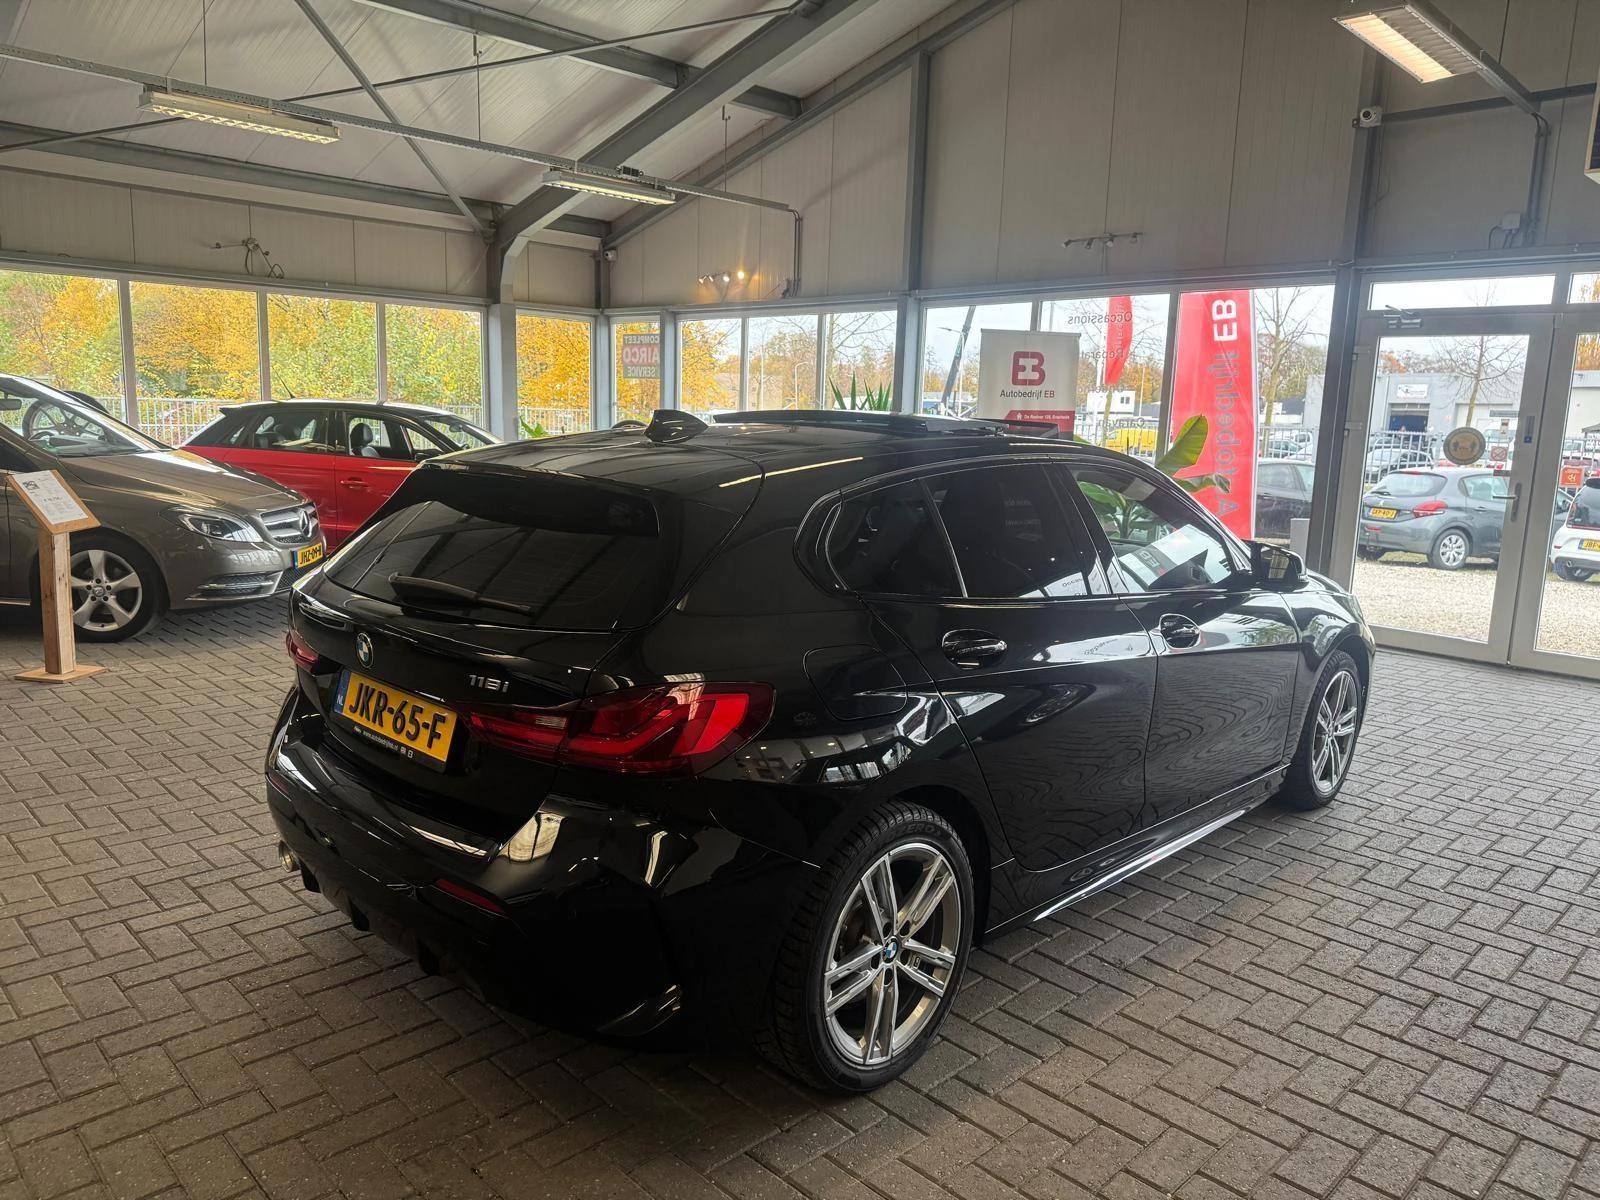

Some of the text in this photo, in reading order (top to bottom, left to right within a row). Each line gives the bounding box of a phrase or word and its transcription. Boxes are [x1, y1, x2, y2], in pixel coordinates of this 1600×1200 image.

[999, 389, 1055, 400] Autobedrijf EB
[469, 674, 509, 693] 118i
[336, 693, 344, 706] NL
[348, 682, 447, 749] JKR-65-F
